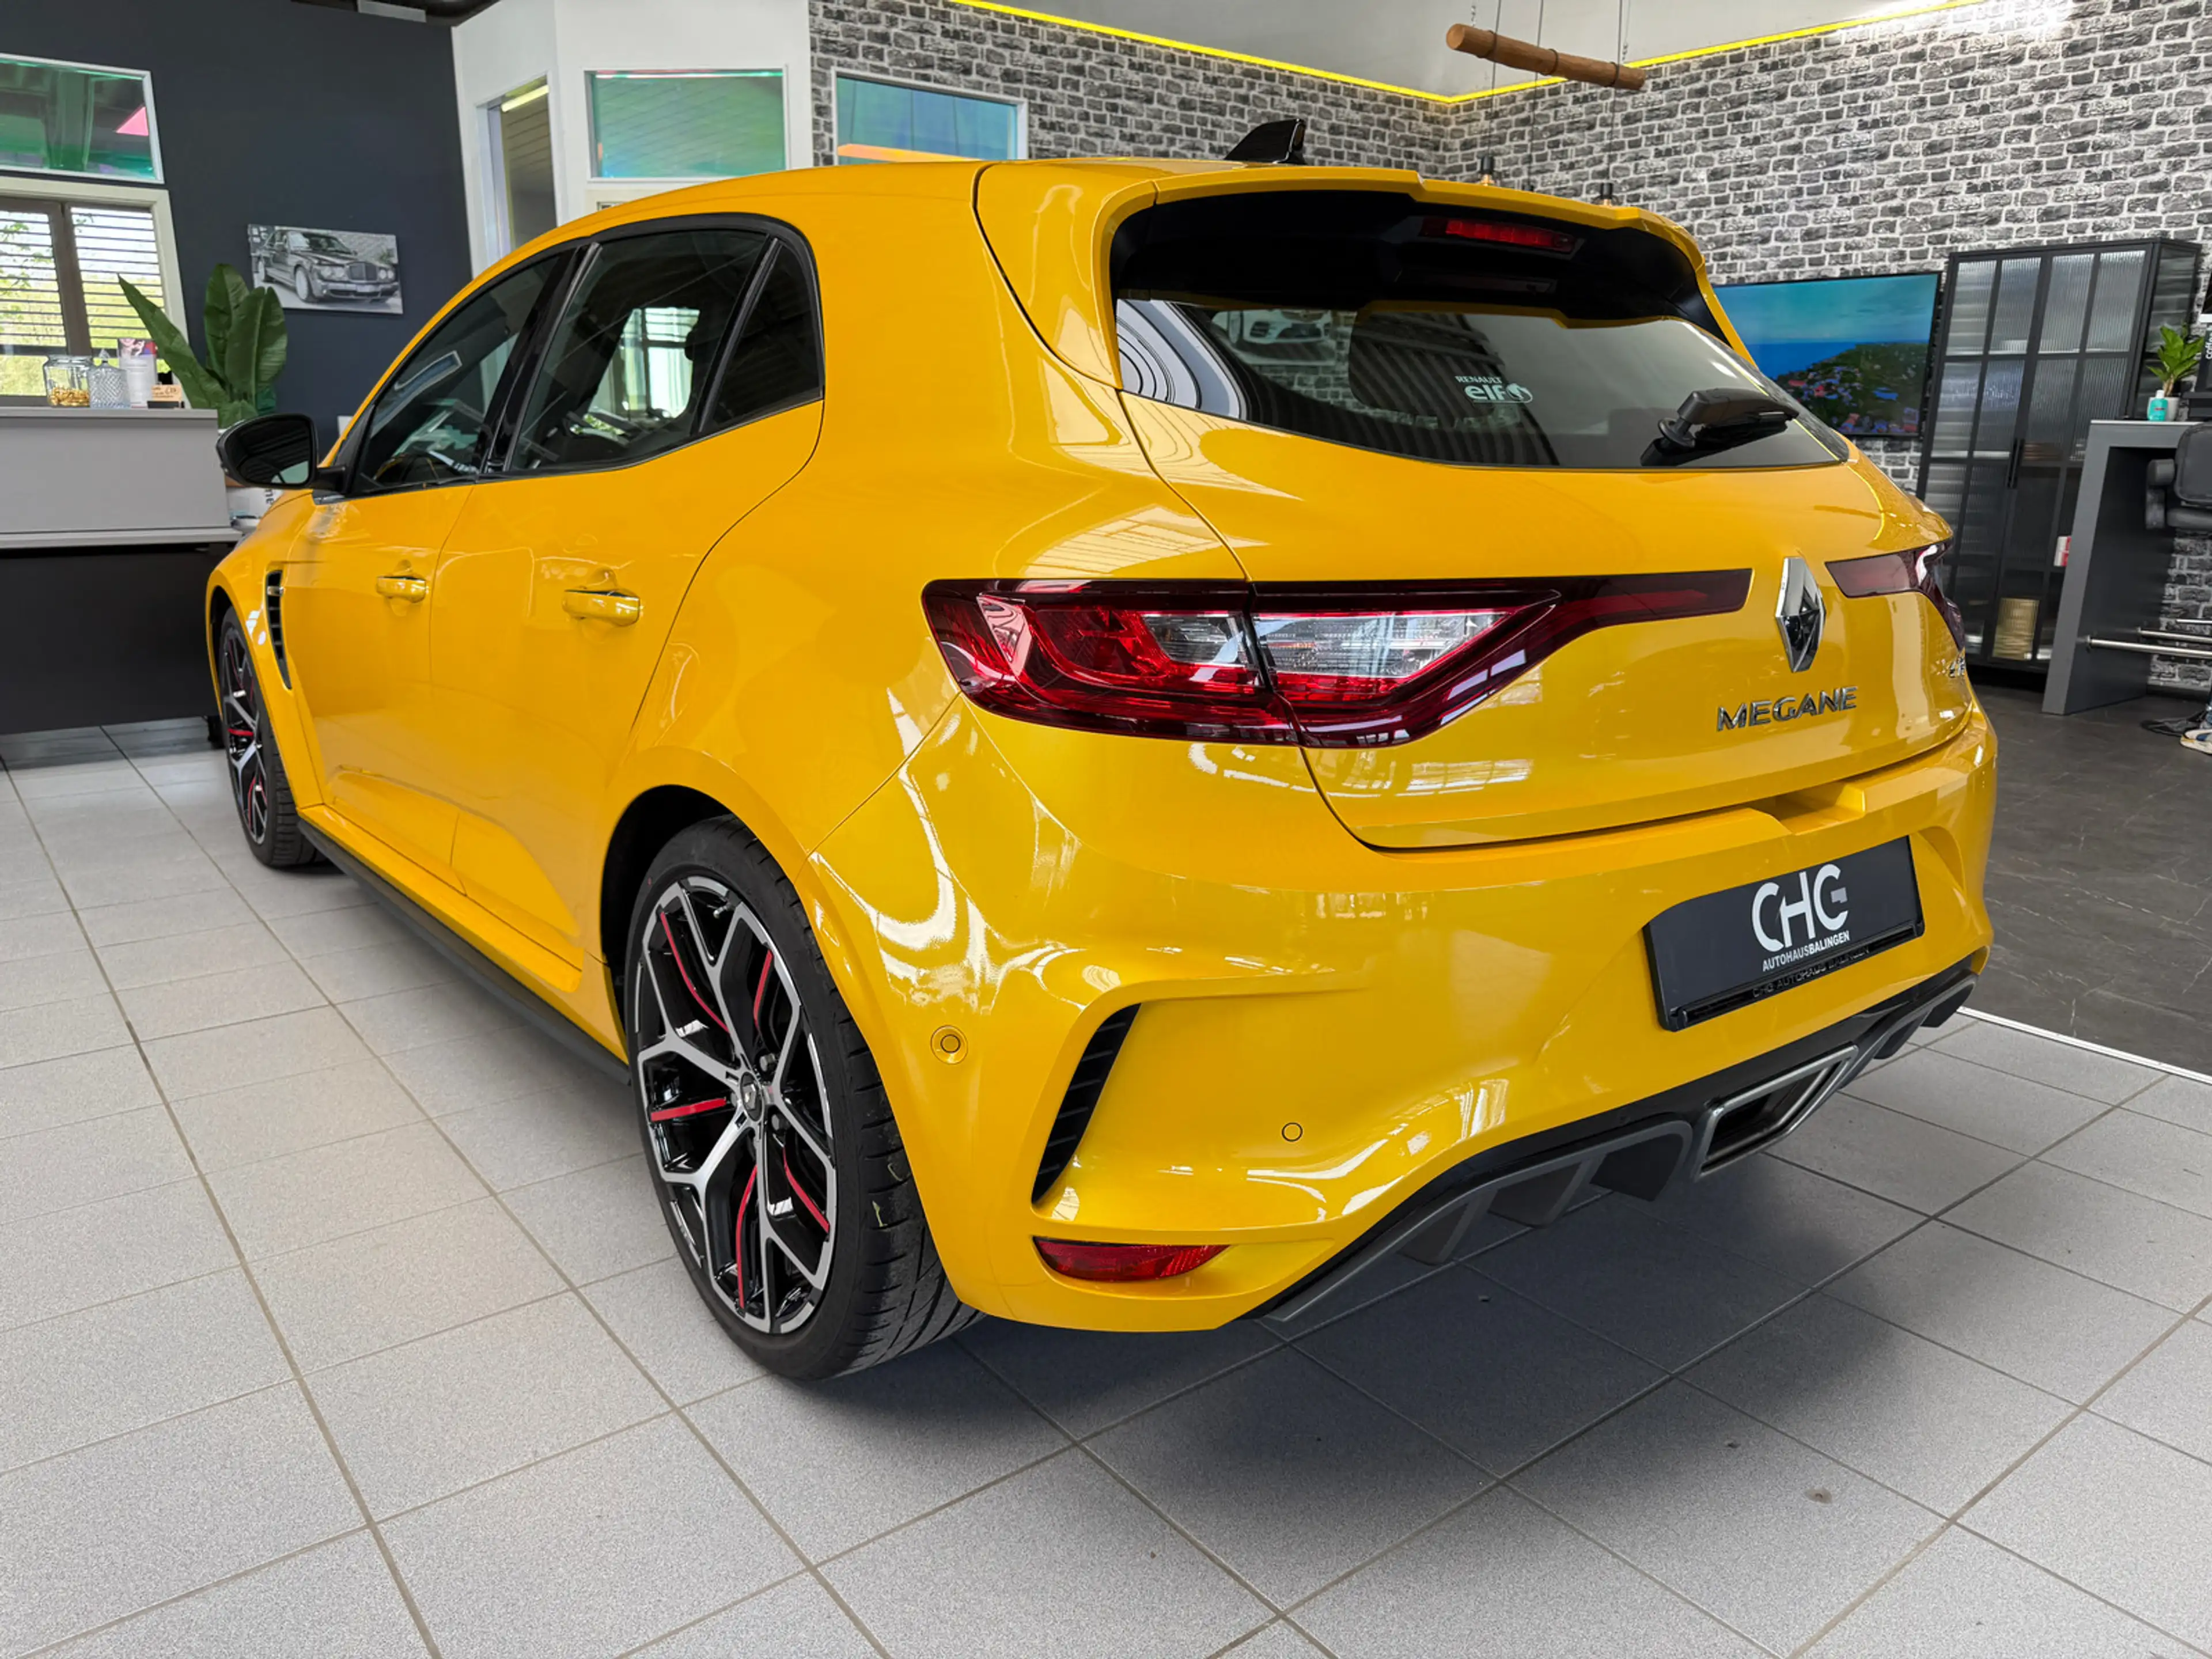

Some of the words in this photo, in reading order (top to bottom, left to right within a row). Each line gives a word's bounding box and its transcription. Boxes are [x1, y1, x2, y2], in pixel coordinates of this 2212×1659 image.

[1455, 376, 1502, 384] RENAULT
[1464, 384, 1506, 400] elf
[1716, 686, 1858, 732] MEGANE
[1777, 965, 1827, 989] AUTOHAUS
